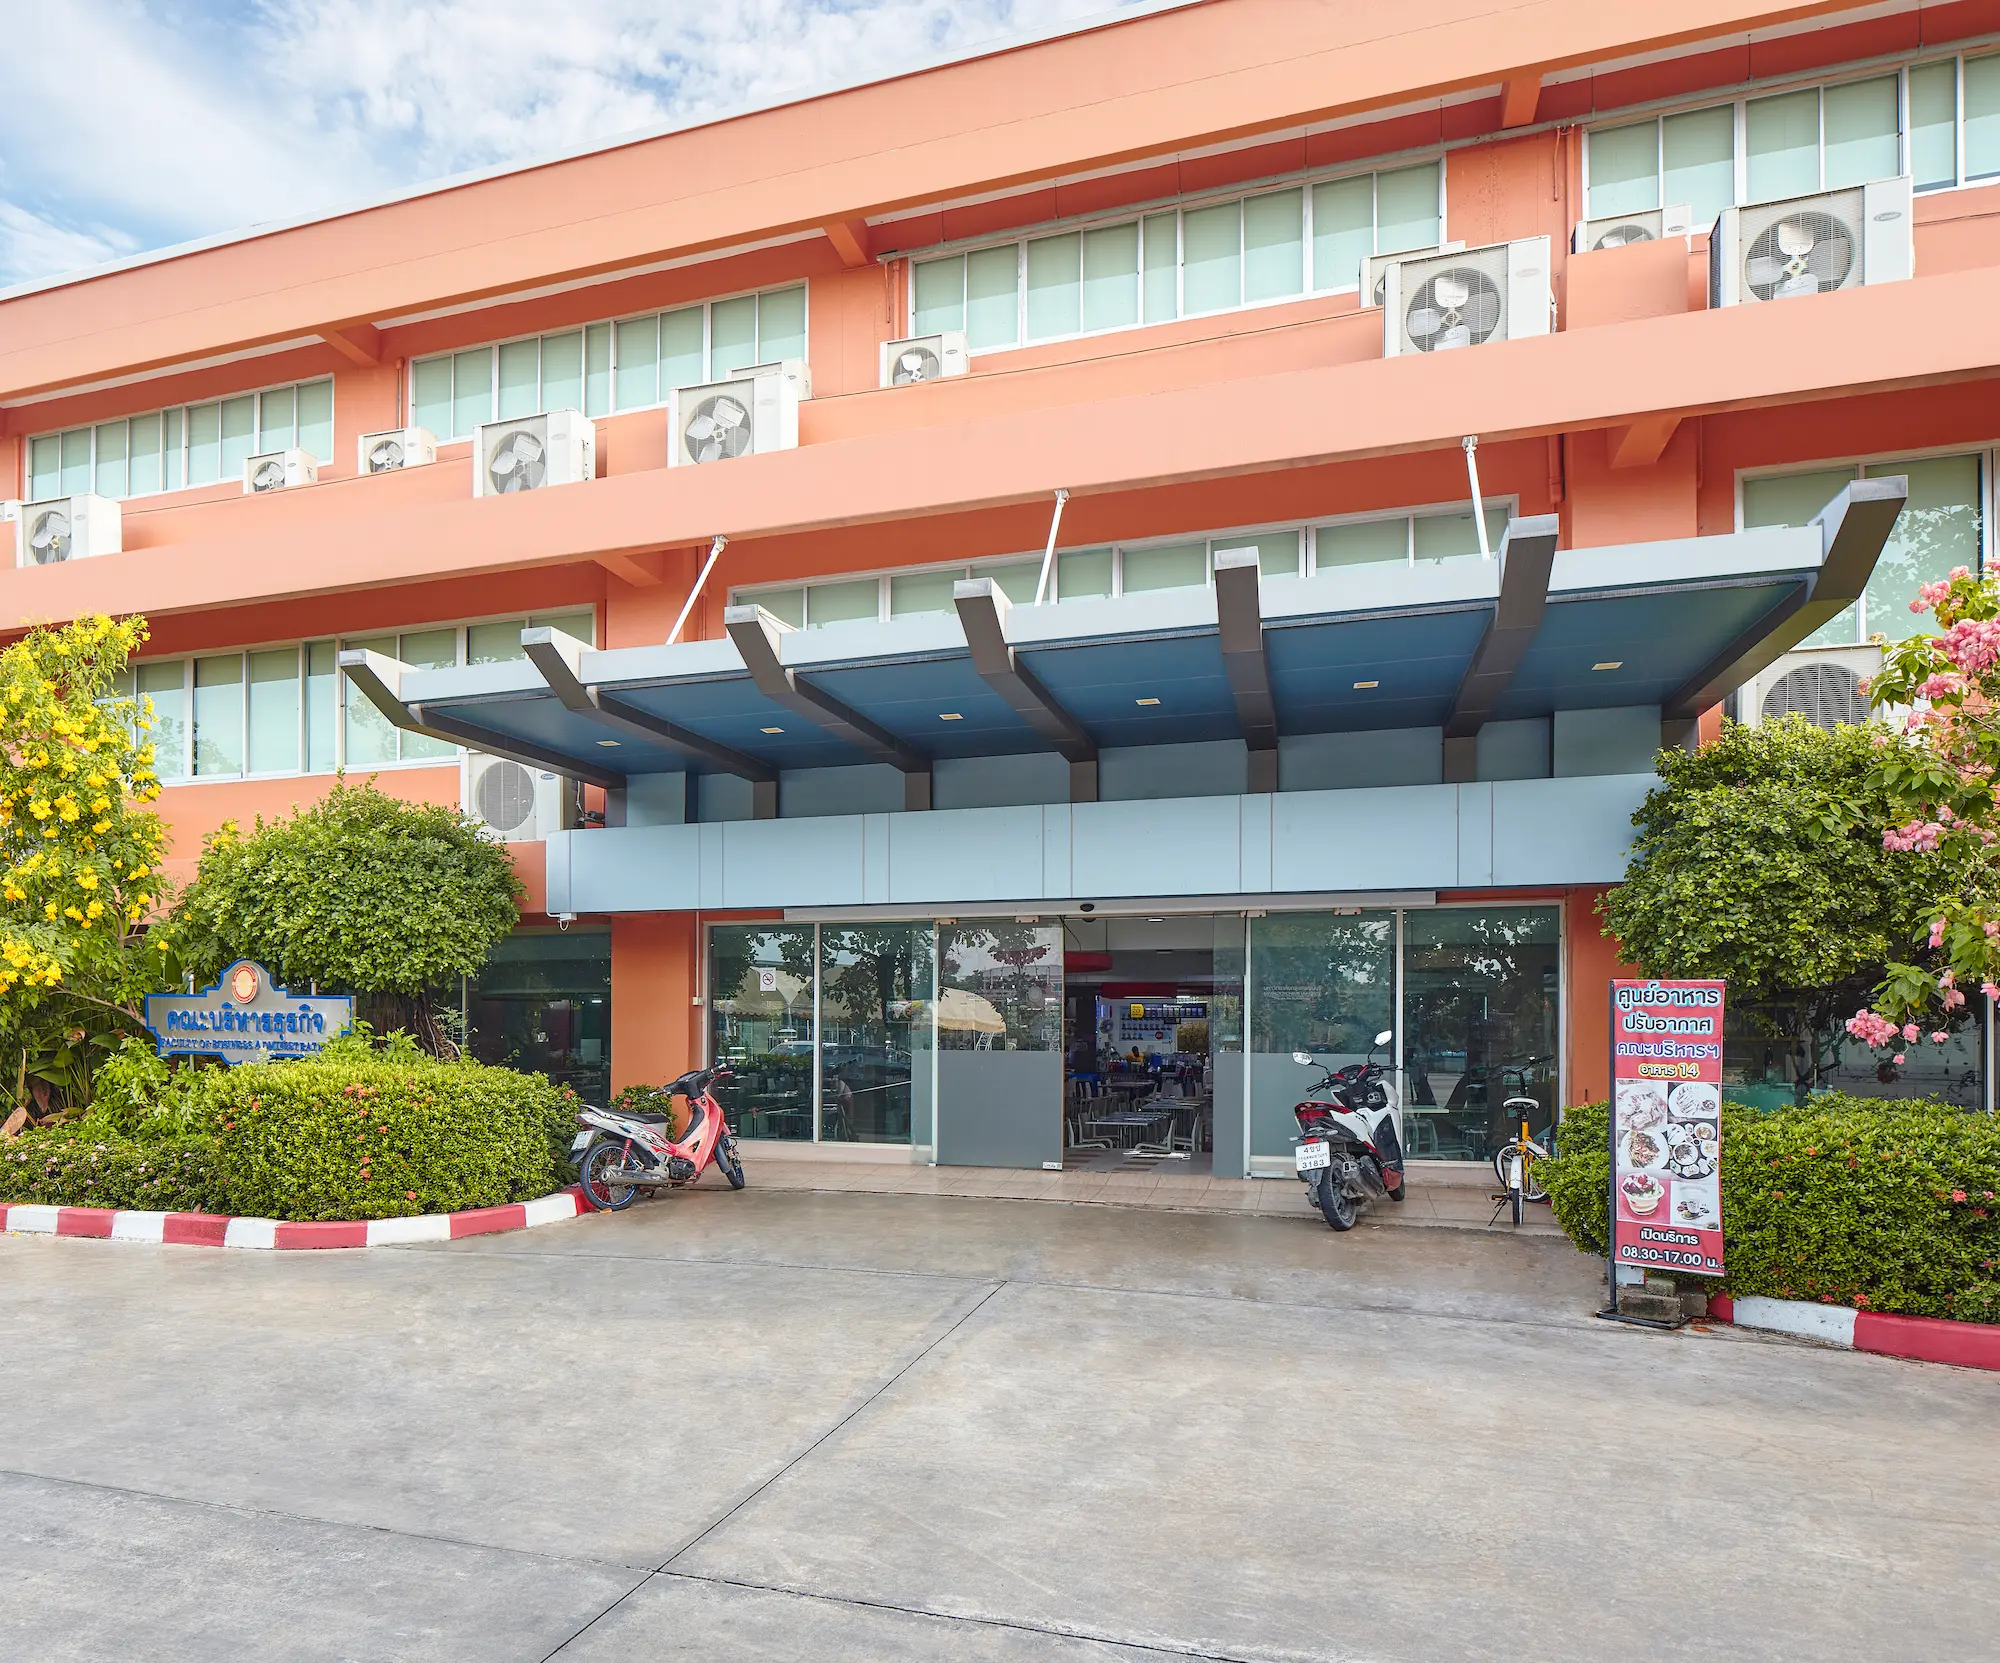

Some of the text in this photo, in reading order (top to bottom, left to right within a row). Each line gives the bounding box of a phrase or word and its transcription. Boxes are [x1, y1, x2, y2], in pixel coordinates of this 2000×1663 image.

[1618, 984, 1719, 1009] ศูนย์อาหาร
[166, 1002, 325, 1041] คณะบริหารธุรกิจ
[1625, 1013, 1711, 1032] ปรับอากาศ
[161, 1037, 198, 1048] FACULTY
[1617, 1041, 1719, 1058] คณะบริหารฯ
[1640, 1064, 1698, 1077] อาคาร 14
[1302, 1159, 1325, 1169] 3183
[1640, 1228, 1699, 1245] เปิดบริการ
[1621, 1246, 1701, 1265] 08.30-17.00
